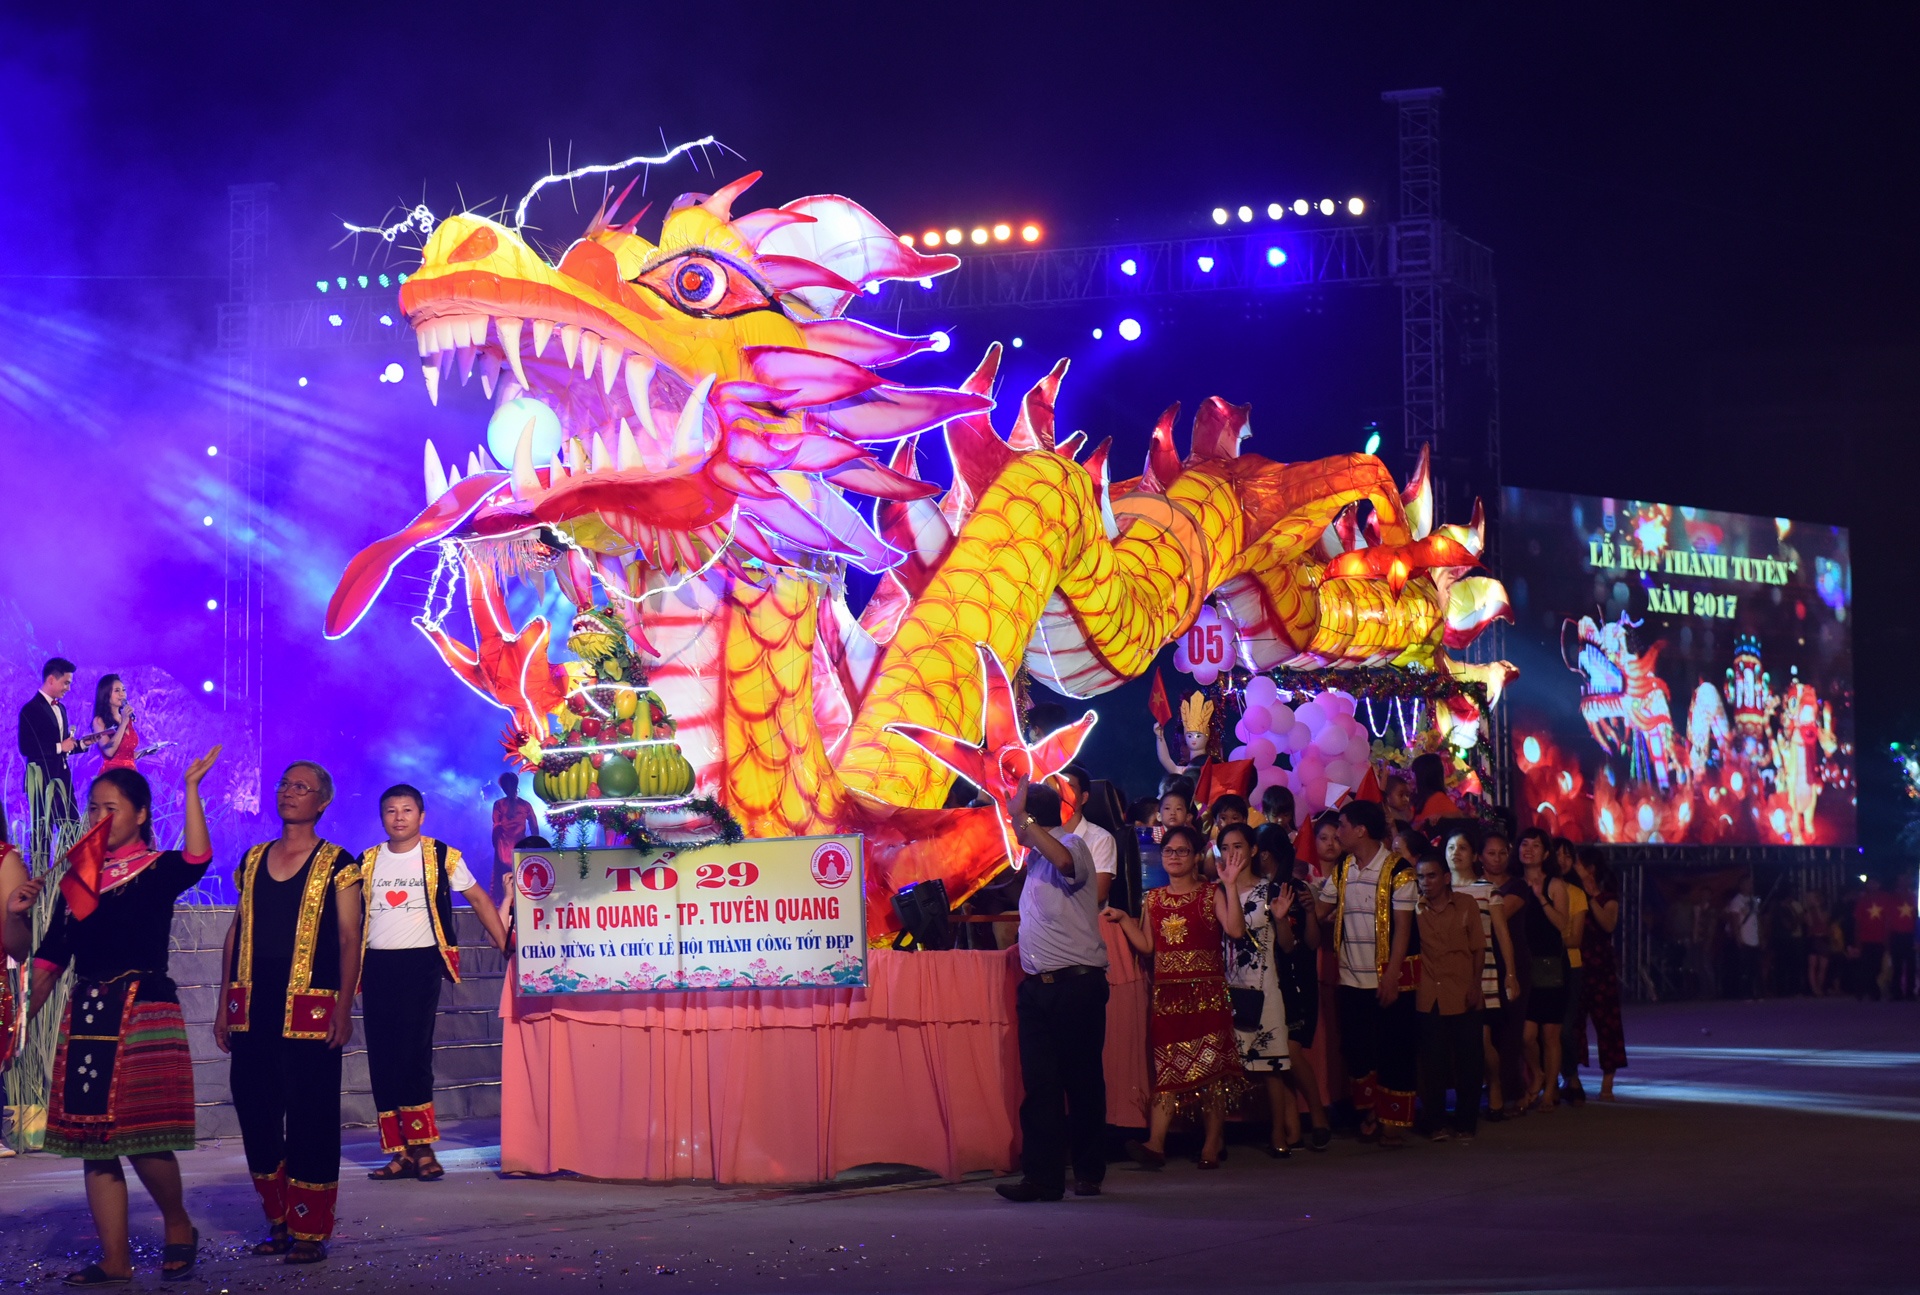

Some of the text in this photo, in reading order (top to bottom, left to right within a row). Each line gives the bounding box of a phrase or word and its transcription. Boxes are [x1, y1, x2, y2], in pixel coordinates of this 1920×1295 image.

[1589, 532, 1616, 569] LỄ
[1664, 546, 1728, 580] THÀNH
[1731, 554, 1788, 586] TUYÊN
[1647, 582, 1738, 619] NĂM 2017
[1188, 625, 1224, 665] 05
[377, 878, 392, 887] Love
[408, 877, 424, 887] Quố
[605, 851, 759, 892] TỔ 29
[533, 907, 550, 930] P.
[555, 902, 591, 929] TÂN
[596, 904, 659, 931] QUANG
[676, 903, 704, 926] TP.
[710, 895, 769, 924] TUYÊN
[775, 896, 840, 924] QUANG
[521, 929, 854, 959] CHÀO MỪNG VÀ CHÚC LỄ HỘI THÀNH CÔNG TỐT ĐẸP
